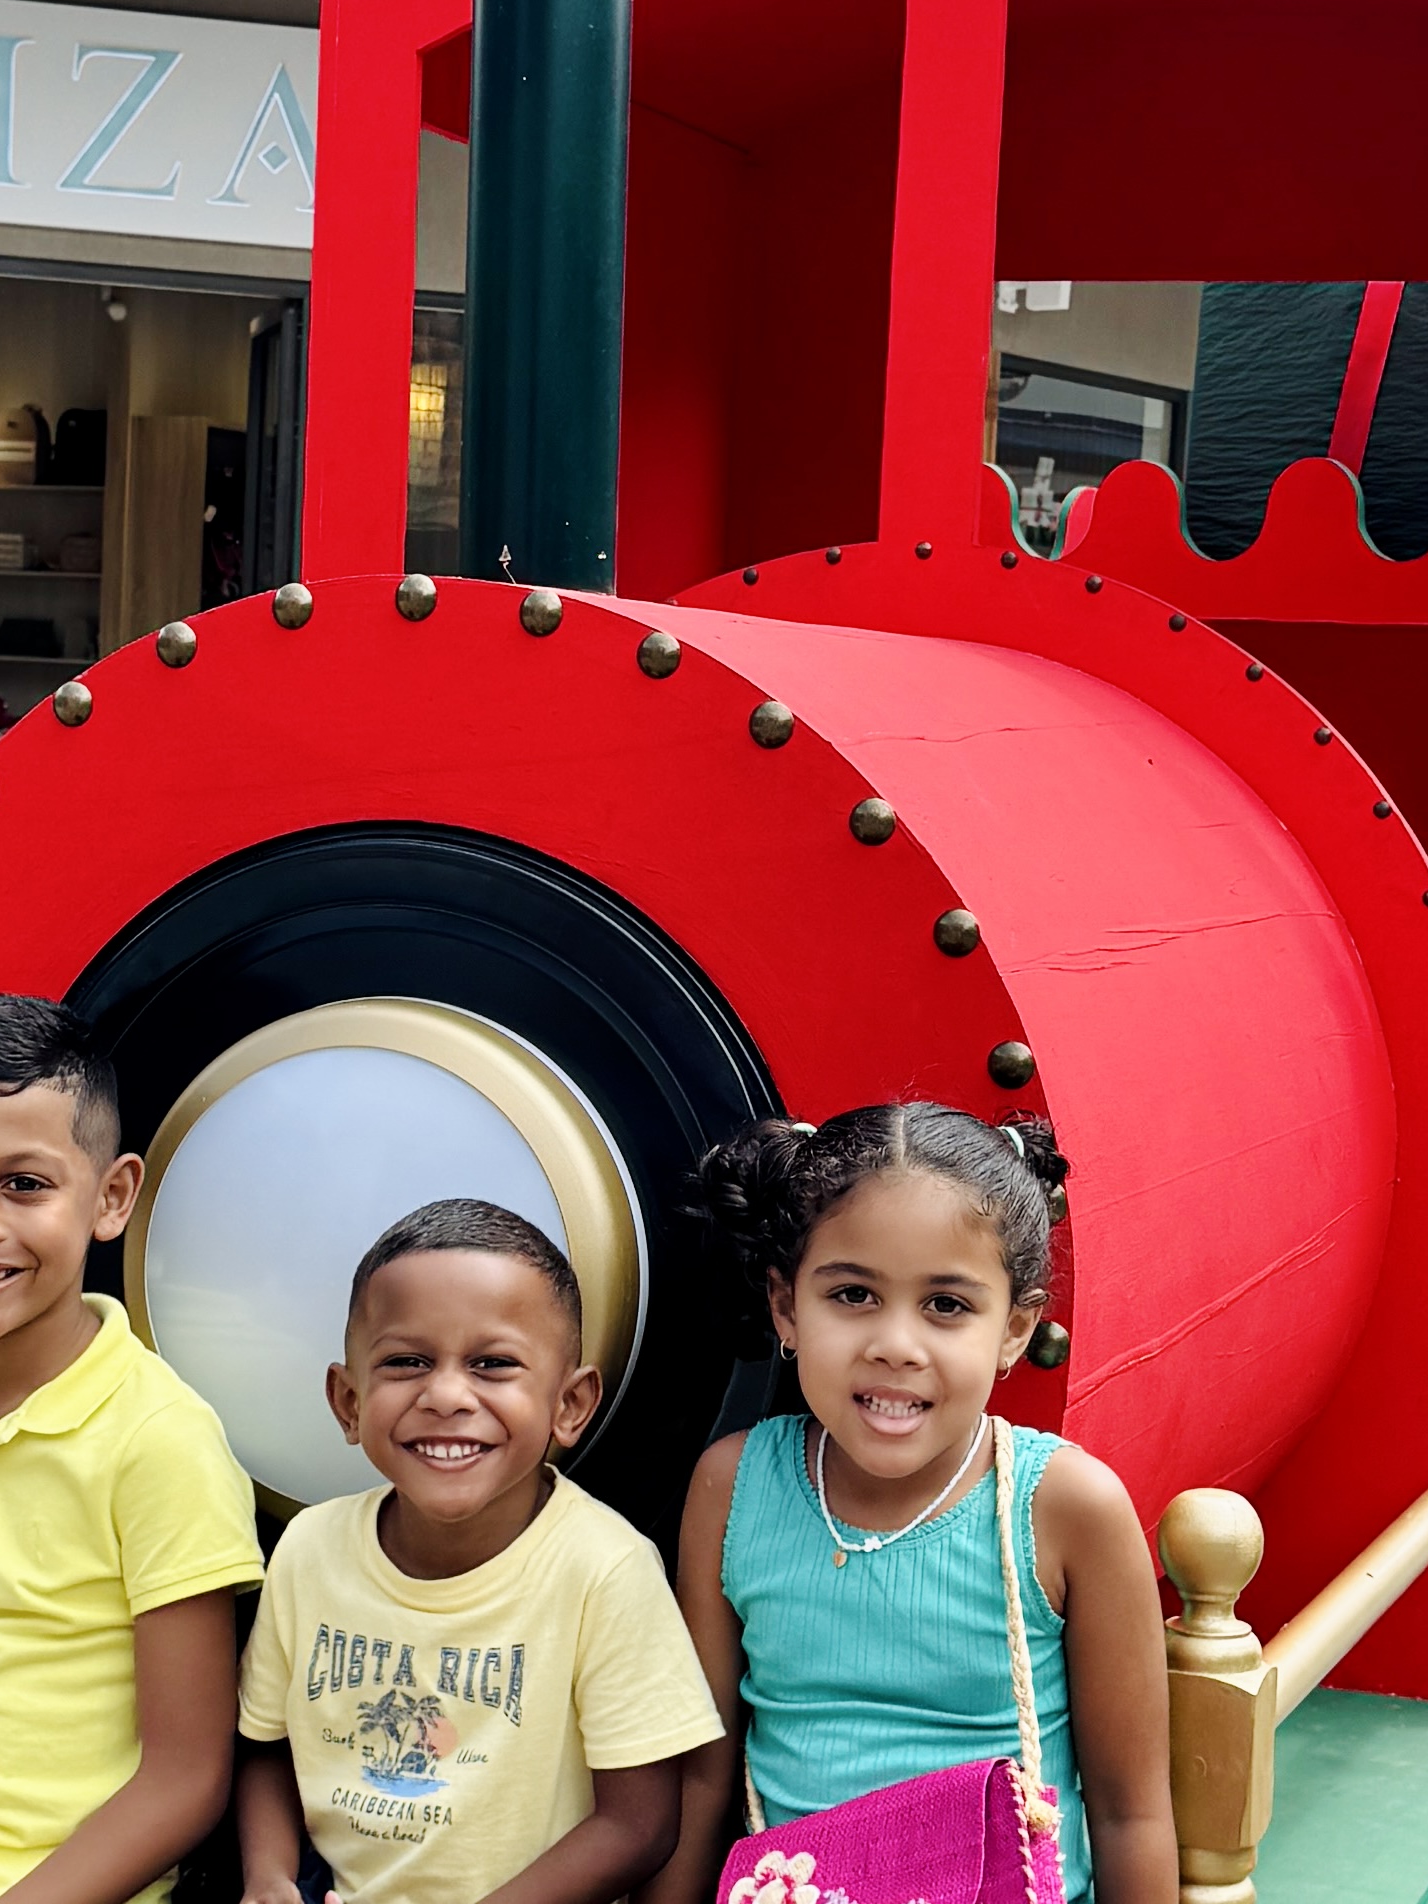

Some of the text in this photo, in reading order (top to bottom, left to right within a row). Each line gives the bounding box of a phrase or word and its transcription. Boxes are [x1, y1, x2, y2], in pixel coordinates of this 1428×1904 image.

[307, 1622, 526, 1728] COSTA RICA
[330, 1786, 454, 1827] CARIBBEAN SEA
